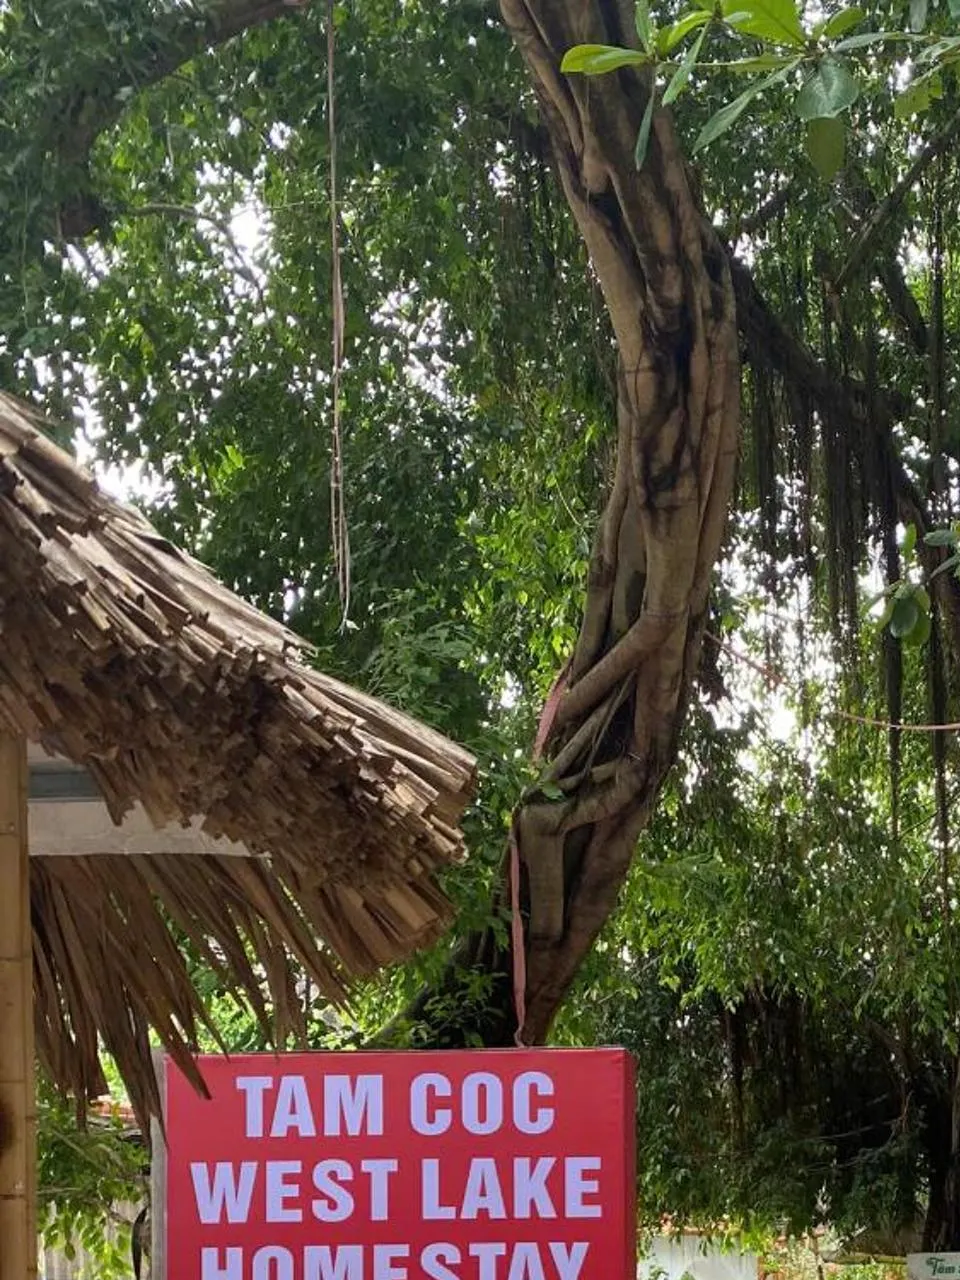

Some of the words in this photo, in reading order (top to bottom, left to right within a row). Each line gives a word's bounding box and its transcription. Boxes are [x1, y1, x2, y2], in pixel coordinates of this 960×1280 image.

[236, 1074, 384, 1138] TAM
[410, 1071, 555, 1136] COC
[190, 1159, 398, 1225] WEST
[421, 1156, 602, 1221] LAKE
